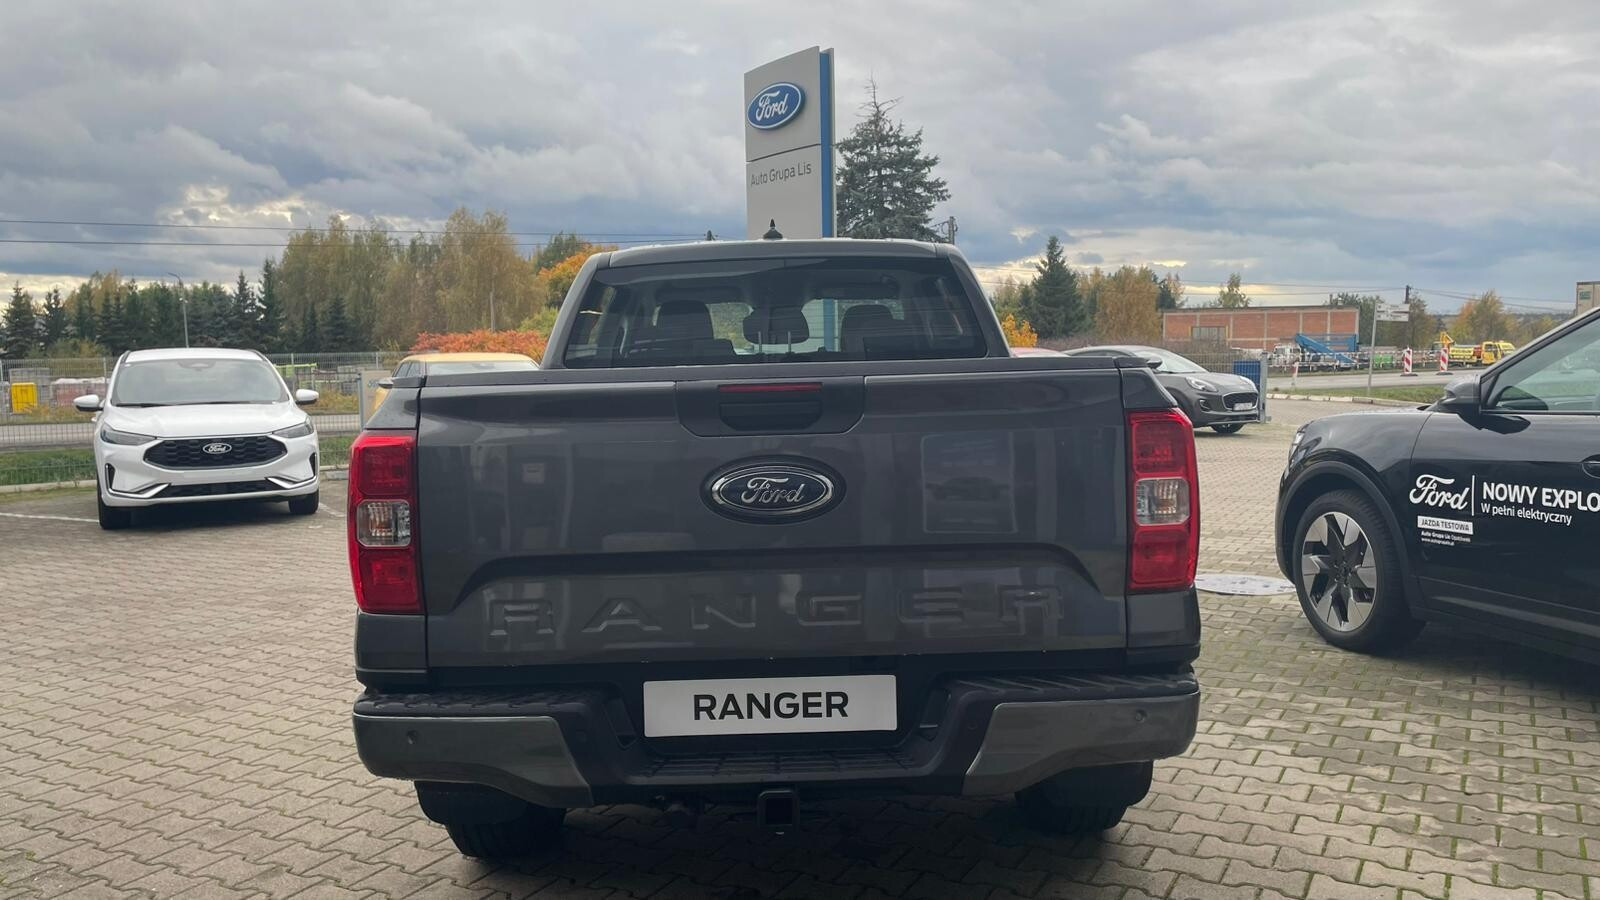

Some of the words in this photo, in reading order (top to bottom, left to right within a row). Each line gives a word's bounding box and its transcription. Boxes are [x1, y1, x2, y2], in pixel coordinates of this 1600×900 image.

[756, 90, 789, 121] Ford
[751, 174, 768, 187] Auto
[769, 167, 796, 182] Grupa
[797, 162, 812, 175] Lis
[209, 444, 226, 452] Ford
[741, 477, 805, 503] Ford
[1409, 474, 1470, 510] Ford
[1483, 482, 1538, 504] NOWY
[1541, 488, 1600, 512] EXPLO
[1421, 519, 1440, 527] JAZDA
[1441, 521, 1470, 531] TESTOWA
[1480, 503, 1491, 514] W
[1492, 504, 1515, 519] pełni
[1517, 509, 1572, 526] elektryczny
[487, 583, 1063, 637] RANGER
[693, 692, 849, 721] RANGER
